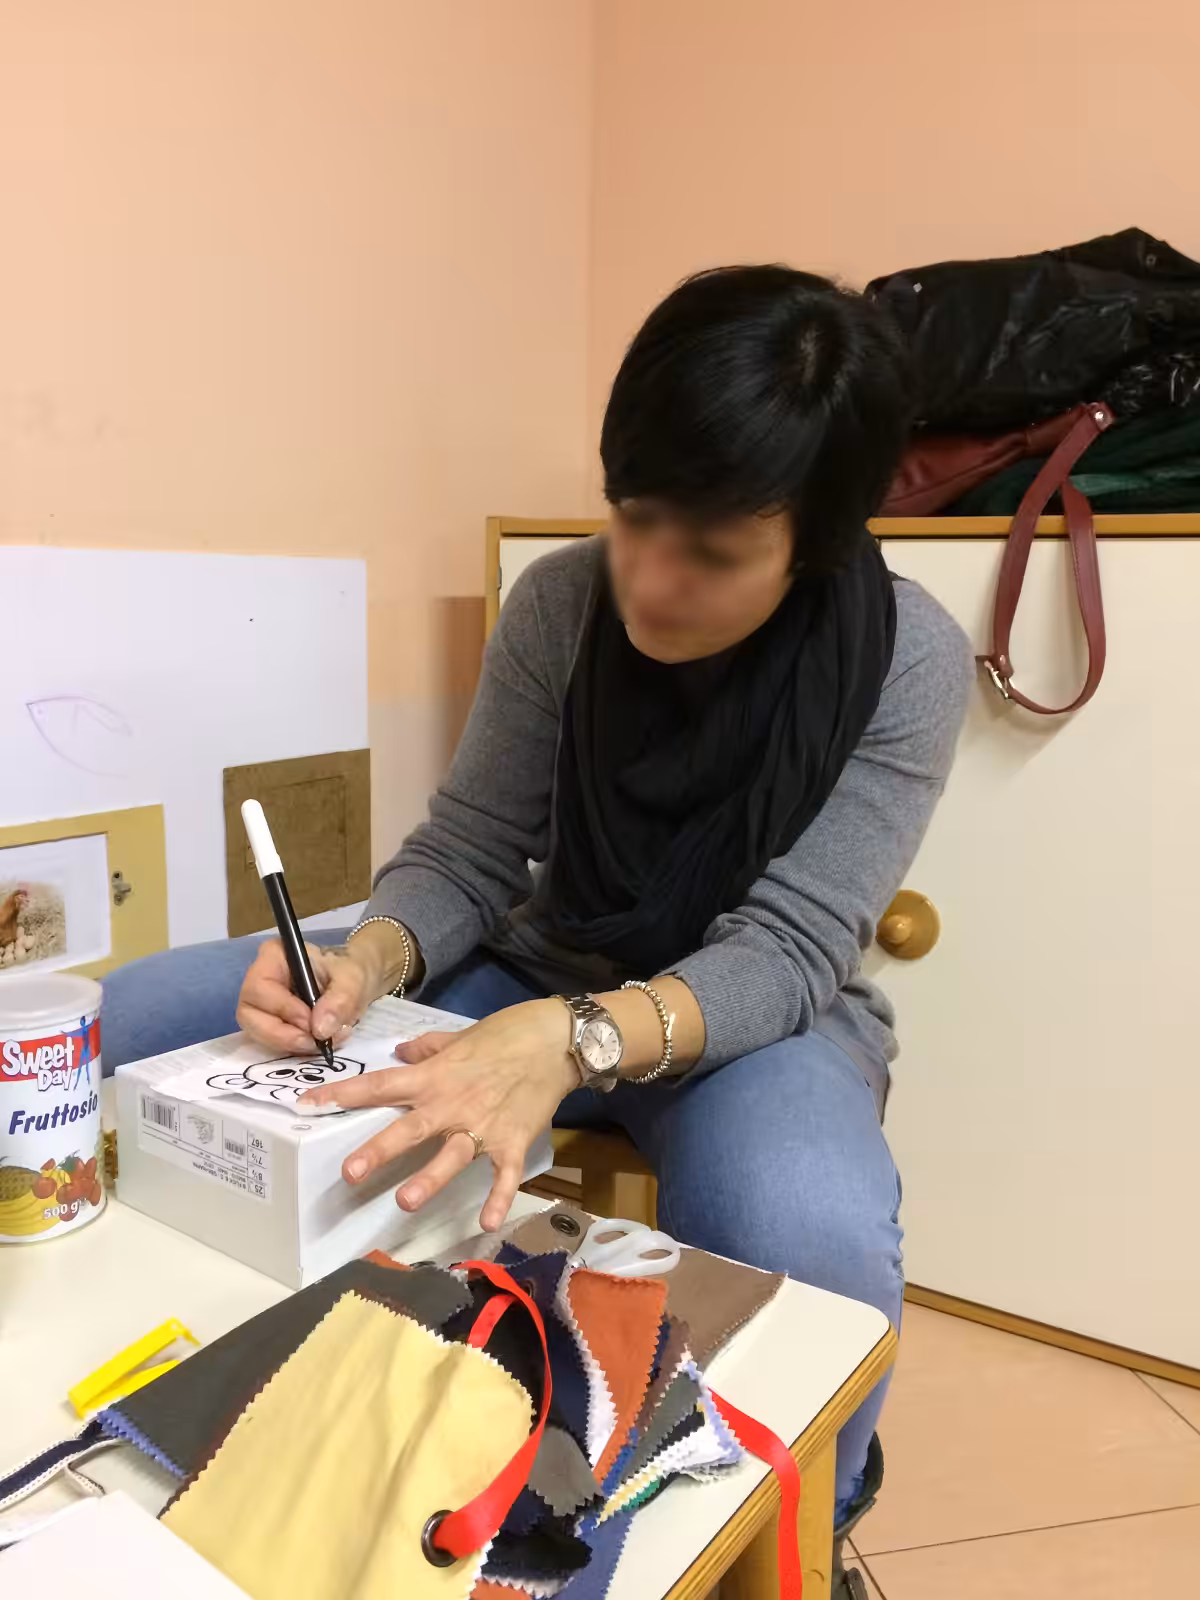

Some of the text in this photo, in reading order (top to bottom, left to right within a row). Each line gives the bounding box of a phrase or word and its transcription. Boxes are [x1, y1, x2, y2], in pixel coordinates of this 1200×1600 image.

[1, 1036, 74, 1076] Sweet
[37, 1066, 72, 1092] Day
[8, 1090, 98, 1135] Fruttosio
[254, 1184, 263, 1195] 25
[43, 1203, 68, 1219] 500
